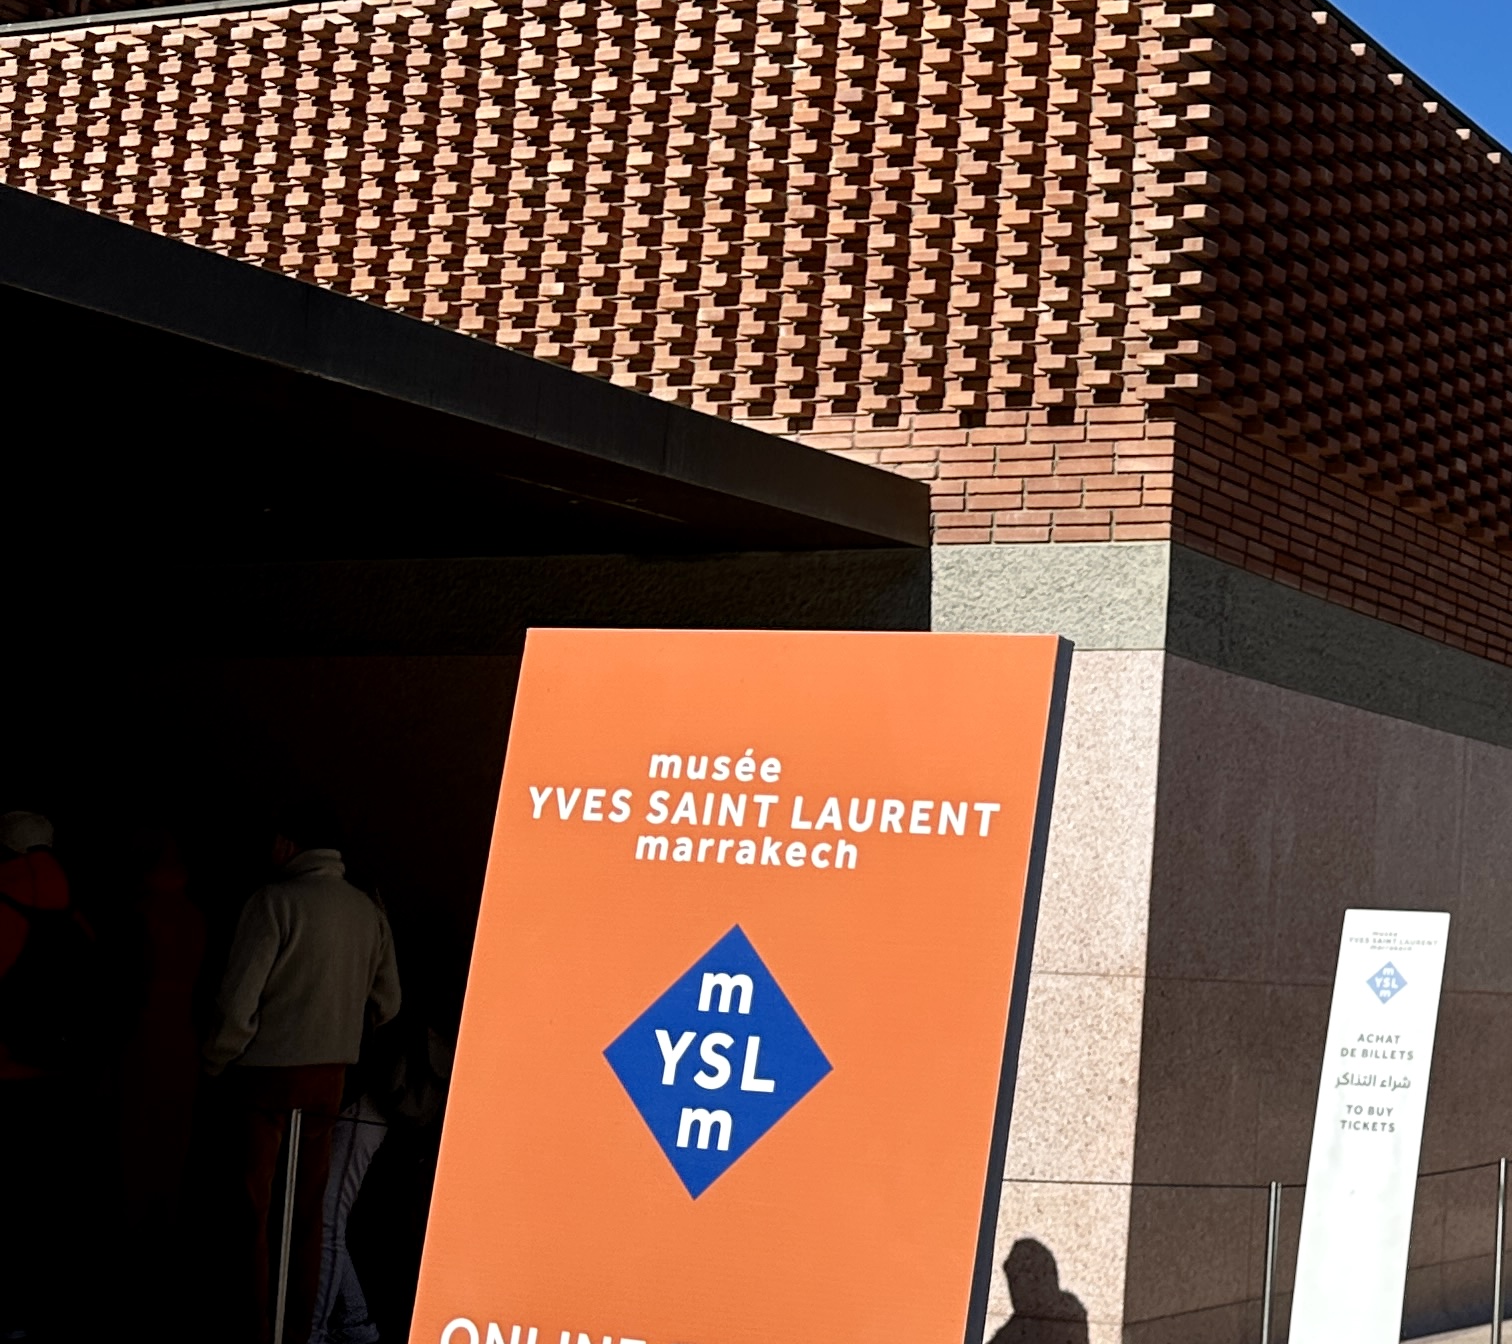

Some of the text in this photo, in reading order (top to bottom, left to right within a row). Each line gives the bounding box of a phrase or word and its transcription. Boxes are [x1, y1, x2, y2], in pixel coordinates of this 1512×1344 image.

[649, 749, 782, 783] musée
[529, 787, 1001, 837] YVES SAINT LAURENT
[635, 834, 858, 869] marrakech
[698, 972, 754, 1014] m
[1375, 977, 1398, 989] YSL
[1357, 1034, 1401, 1044] ACHAT
[655, 1029, 775, 1092] YSL
[1341, 1047, 1414, 1060] DE BILLETS
[1335, 1072, 1411, 1091] شراء التذاكر
[1346, 1105, 1393, 1117] TO BUY
[677, 1107, 732, 1151] m
[1340, 1120, 1395, 1132] TICKETS
